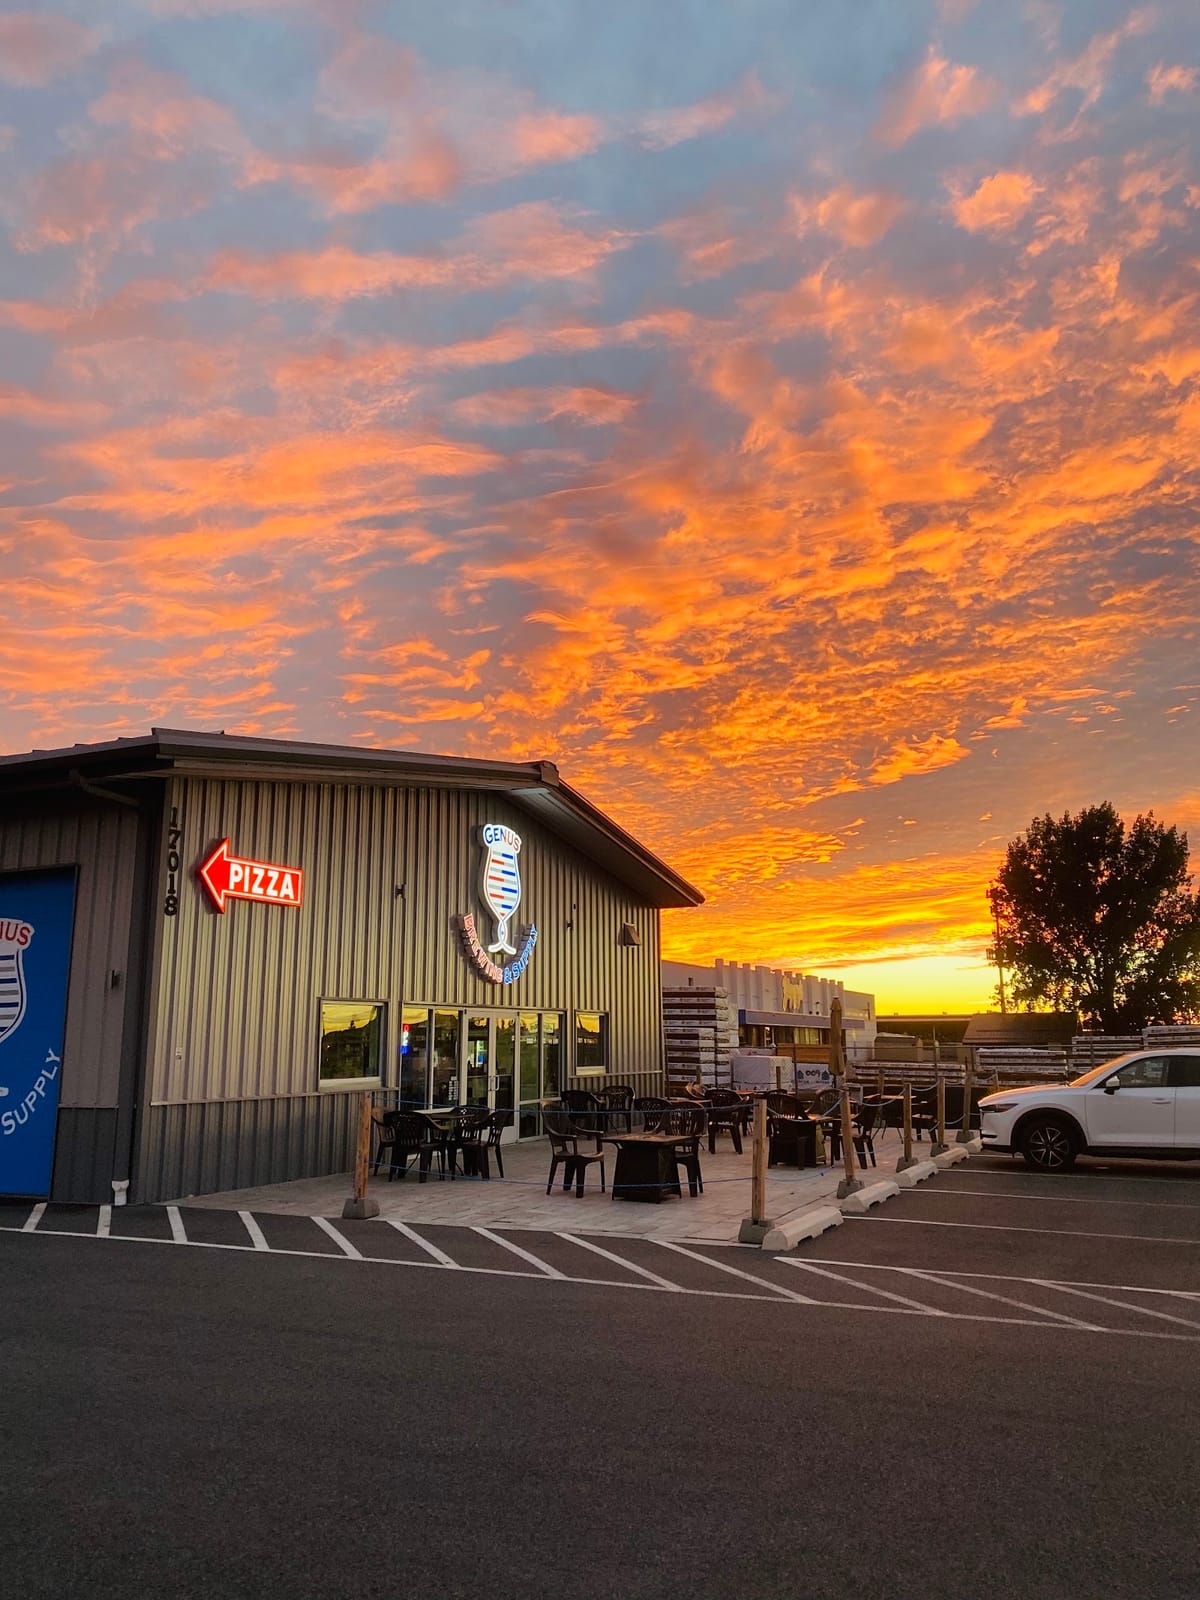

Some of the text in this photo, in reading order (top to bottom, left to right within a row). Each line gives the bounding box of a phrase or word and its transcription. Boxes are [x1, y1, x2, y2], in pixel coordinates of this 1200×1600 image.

[164, 806, 181, 916] 17018
[484, 826, 520, 852] GENUS
[228, 862, 295, 900] PIZZA
[1, 1047, 61, 1136] SUPPLY
